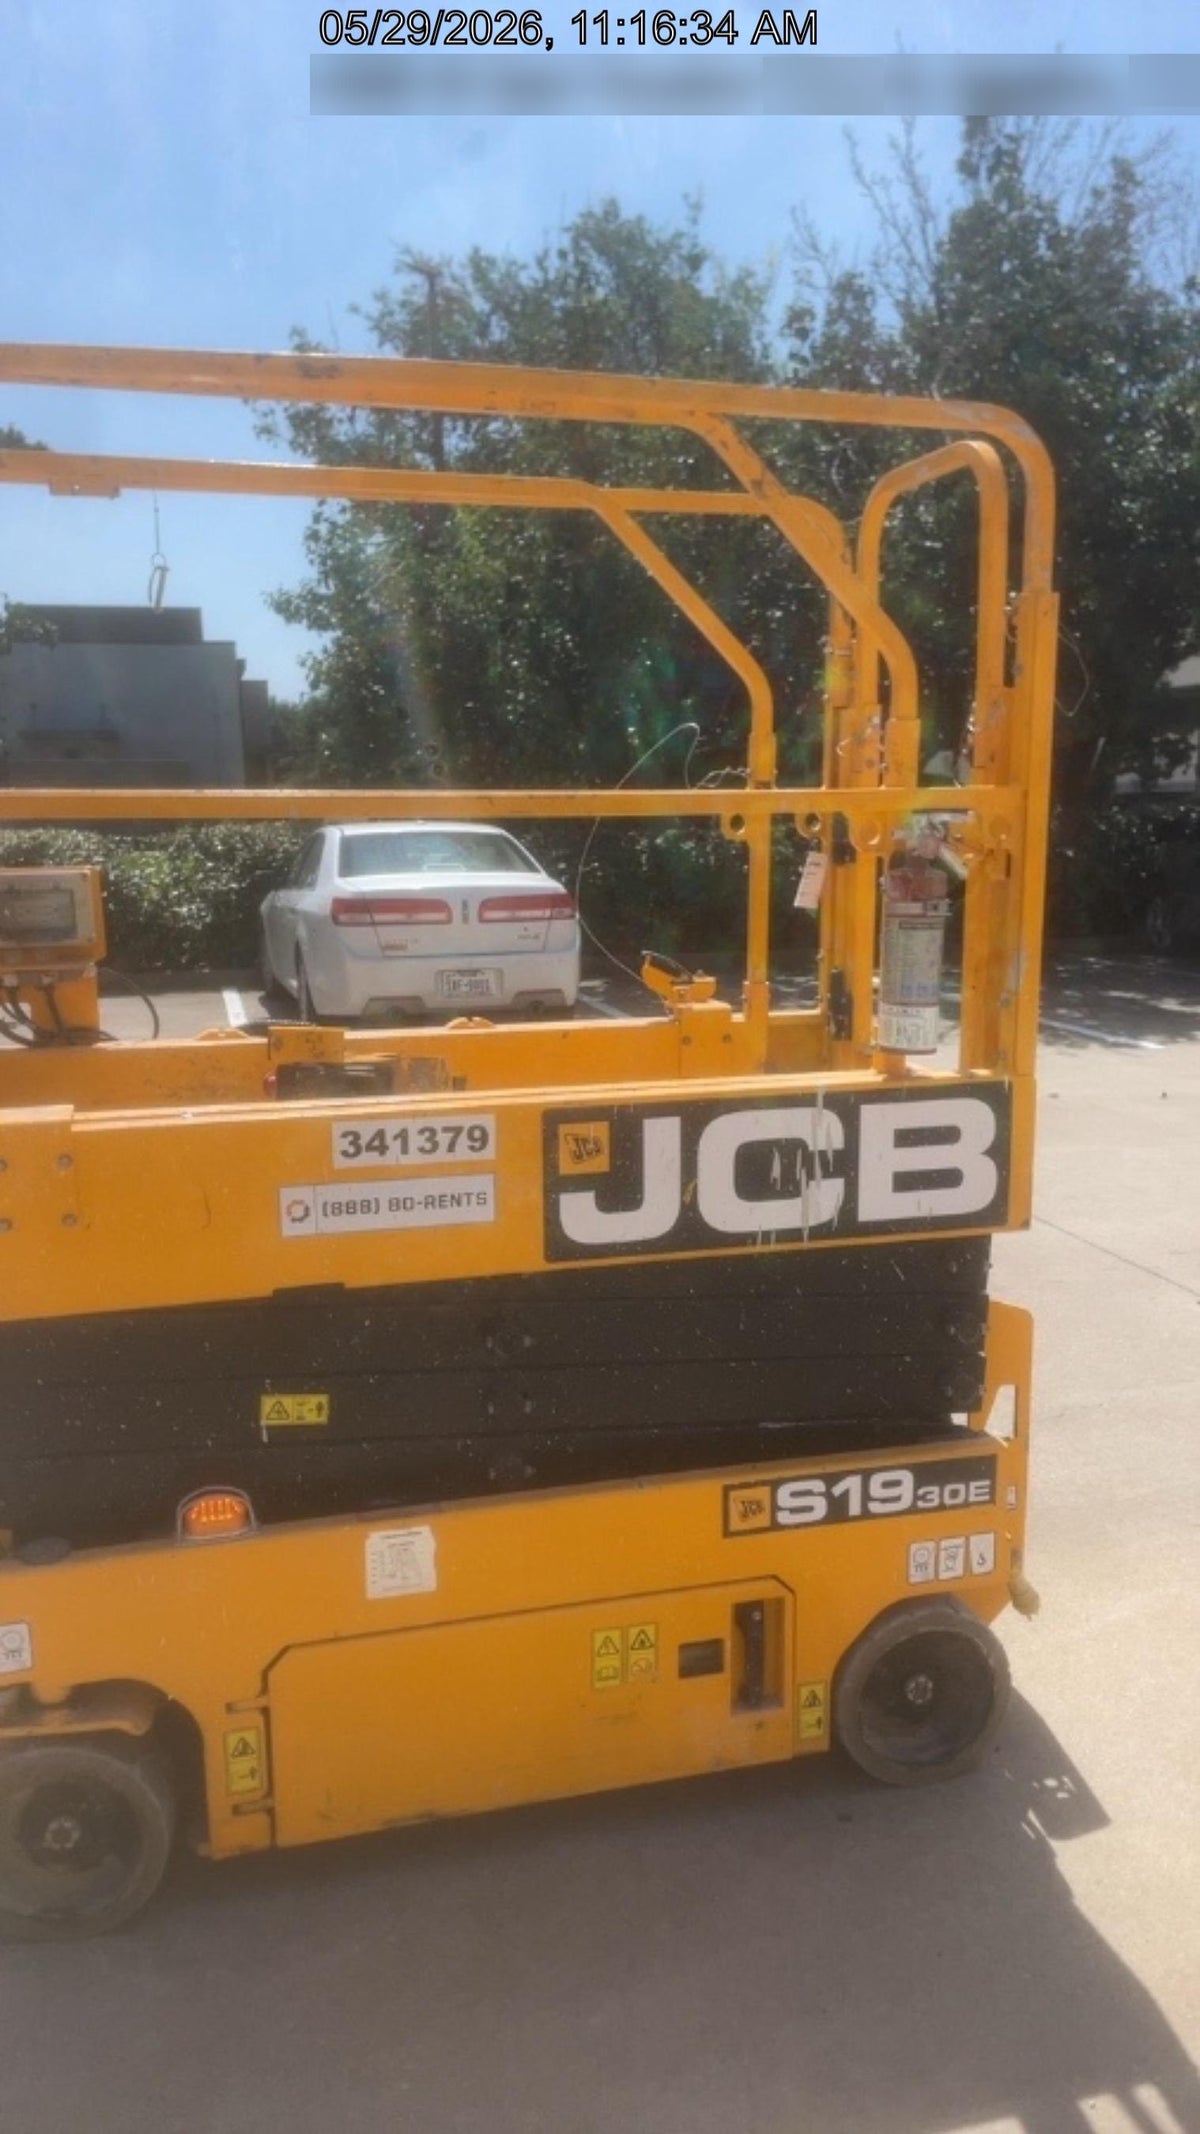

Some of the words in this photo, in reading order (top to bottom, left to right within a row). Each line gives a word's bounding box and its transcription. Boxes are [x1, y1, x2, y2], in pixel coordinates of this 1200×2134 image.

[339, 1124, 490, 1159] 341379
[559, 1097, 998, 1245] JCB
[322, 1197, 380, 1217] (888)
[388, 1191, 488, 1213] 80-RENTS
